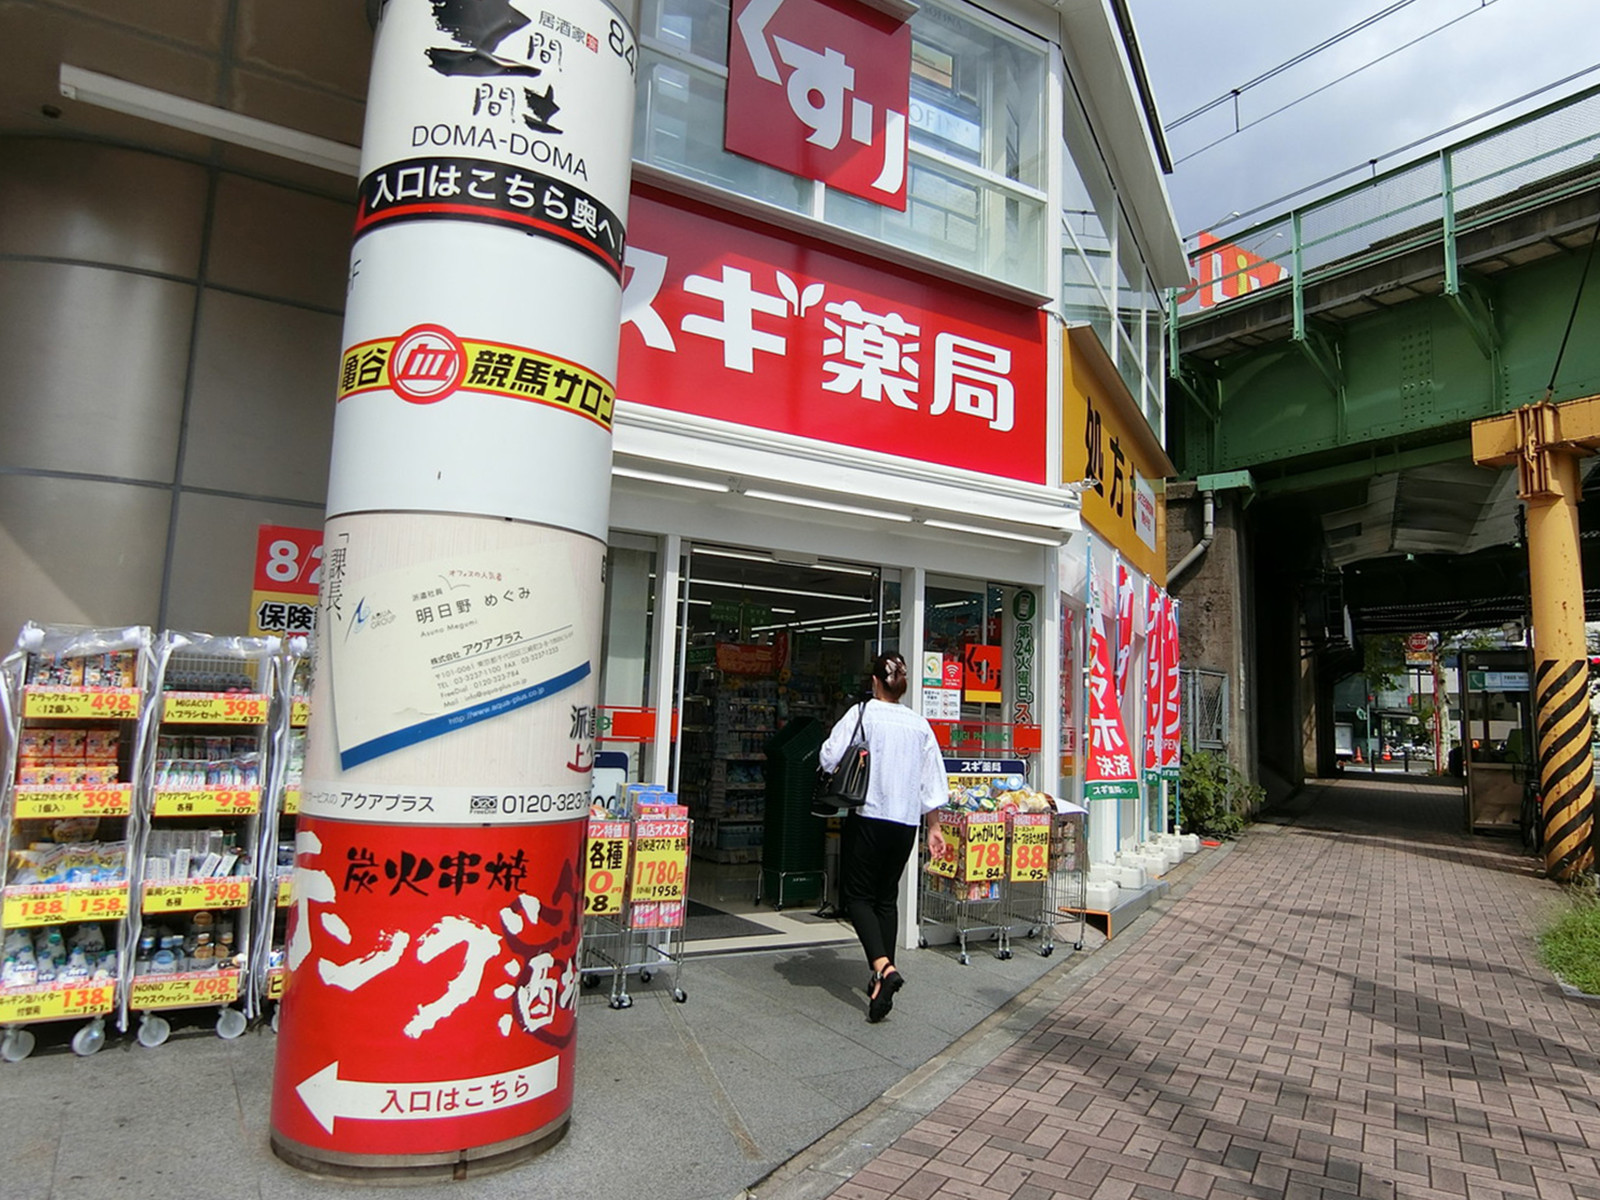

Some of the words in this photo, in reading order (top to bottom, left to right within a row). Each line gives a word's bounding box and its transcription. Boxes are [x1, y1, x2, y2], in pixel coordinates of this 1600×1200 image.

[736, 0, 906, 195] くすり
[411, 124, 589, 182] DOMA-DOMA
[621, 245, 1015, 433] スギ薬局
[468, 349, 613, 426] 競馬サロン
[258, 602, 318, 631] 保険
[416, 598, 472, 625] 明日野
[484, 586, 531, 607] めぐみ
[430, 650, 461, 665] 株式会社
[462, 630, 524, 656] アクアプラス
[961, 761, 1001, 773] スギ薬局
[1096, 754, 1132, 776] 決済
[340, 792, 436, 814] アクアプラス
[637, 822, 687, 838] 当店オススメ
[967, 825, 1004, 843] じゃがりこ
[590, 840, 623, 870] 各種
[342, 847, 530, 897] 炭火串焼
[652, 885, 681, 897] 1958
[134, 982, 164, 993] NONIO
[380, 1074, 531, 1114] 入口はこちら
